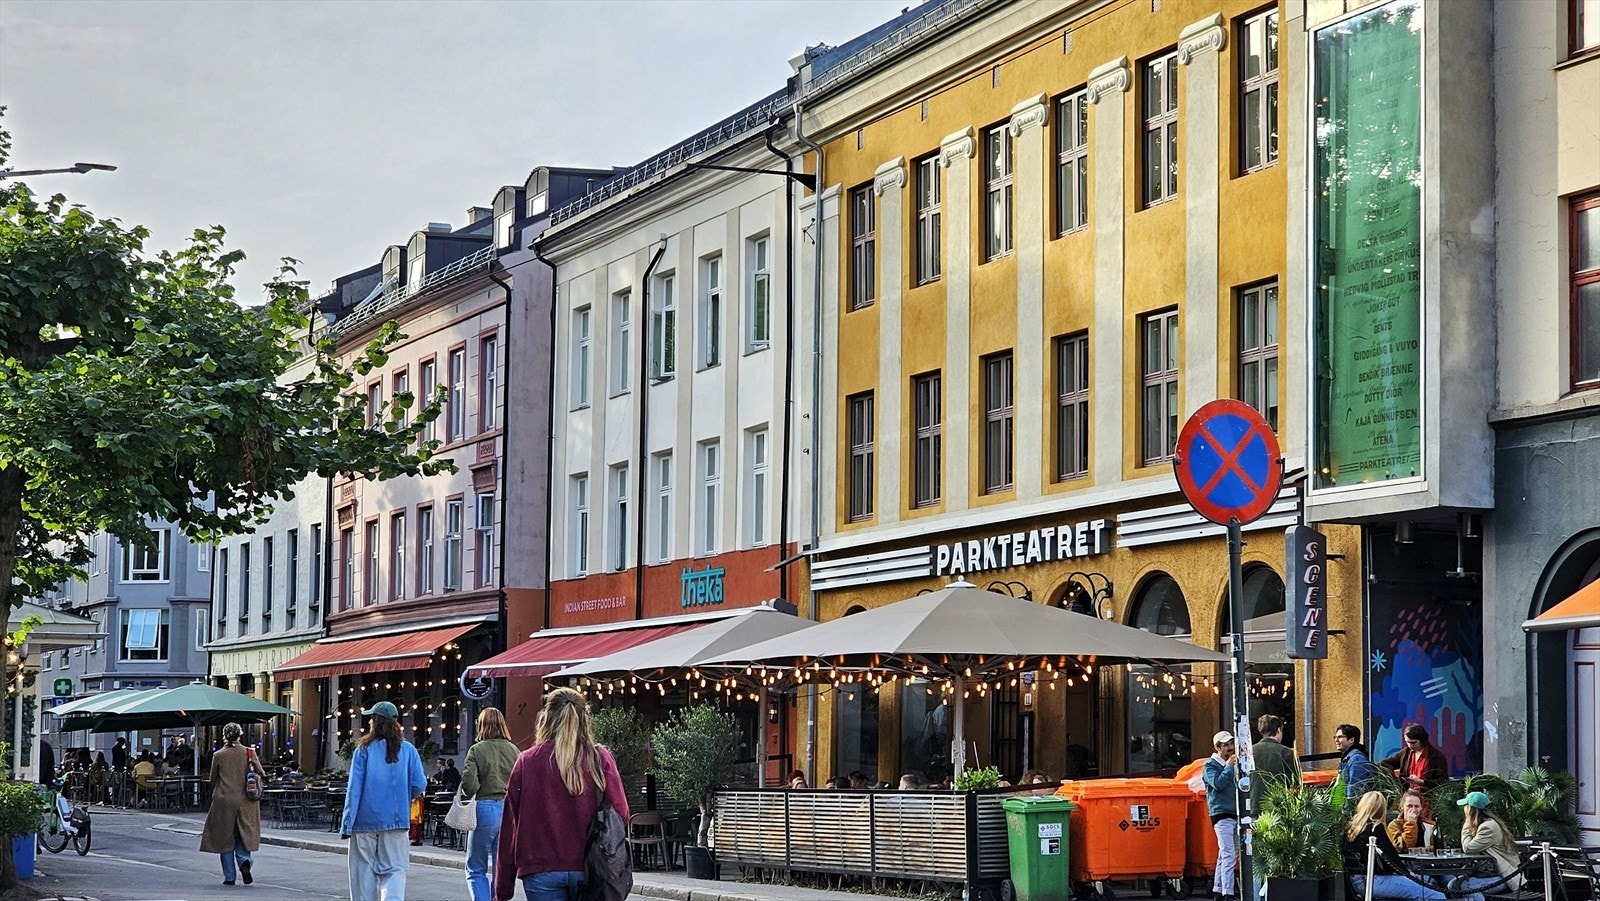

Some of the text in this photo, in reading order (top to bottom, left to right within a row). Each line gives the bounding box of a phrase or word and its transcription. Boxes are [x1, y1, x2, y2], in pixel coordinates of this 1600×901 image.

[1347, 253, 1393, 274] UNDERTAKERS
[1373, 321, 1392, 335] GENTS
[1395, 339, 1418, 352] VUYO
[1358, 369, 1379, 383] BENDIK
[1385, 387, 1403, 400] DIOR
[1372, 434, 1394, 447] ATENA
[1359, 455, 1411, 471] PARKTEATRET
[937, 518, 1106, 577] PARKTEATRET
[681, 562, 725, 608] theka
[1302, 541, 1322, 649] SCENE
[564, 595, 626, 613] INDIAN STREET FOOD & BAR
[222, 652, 249, 673] VILLA
